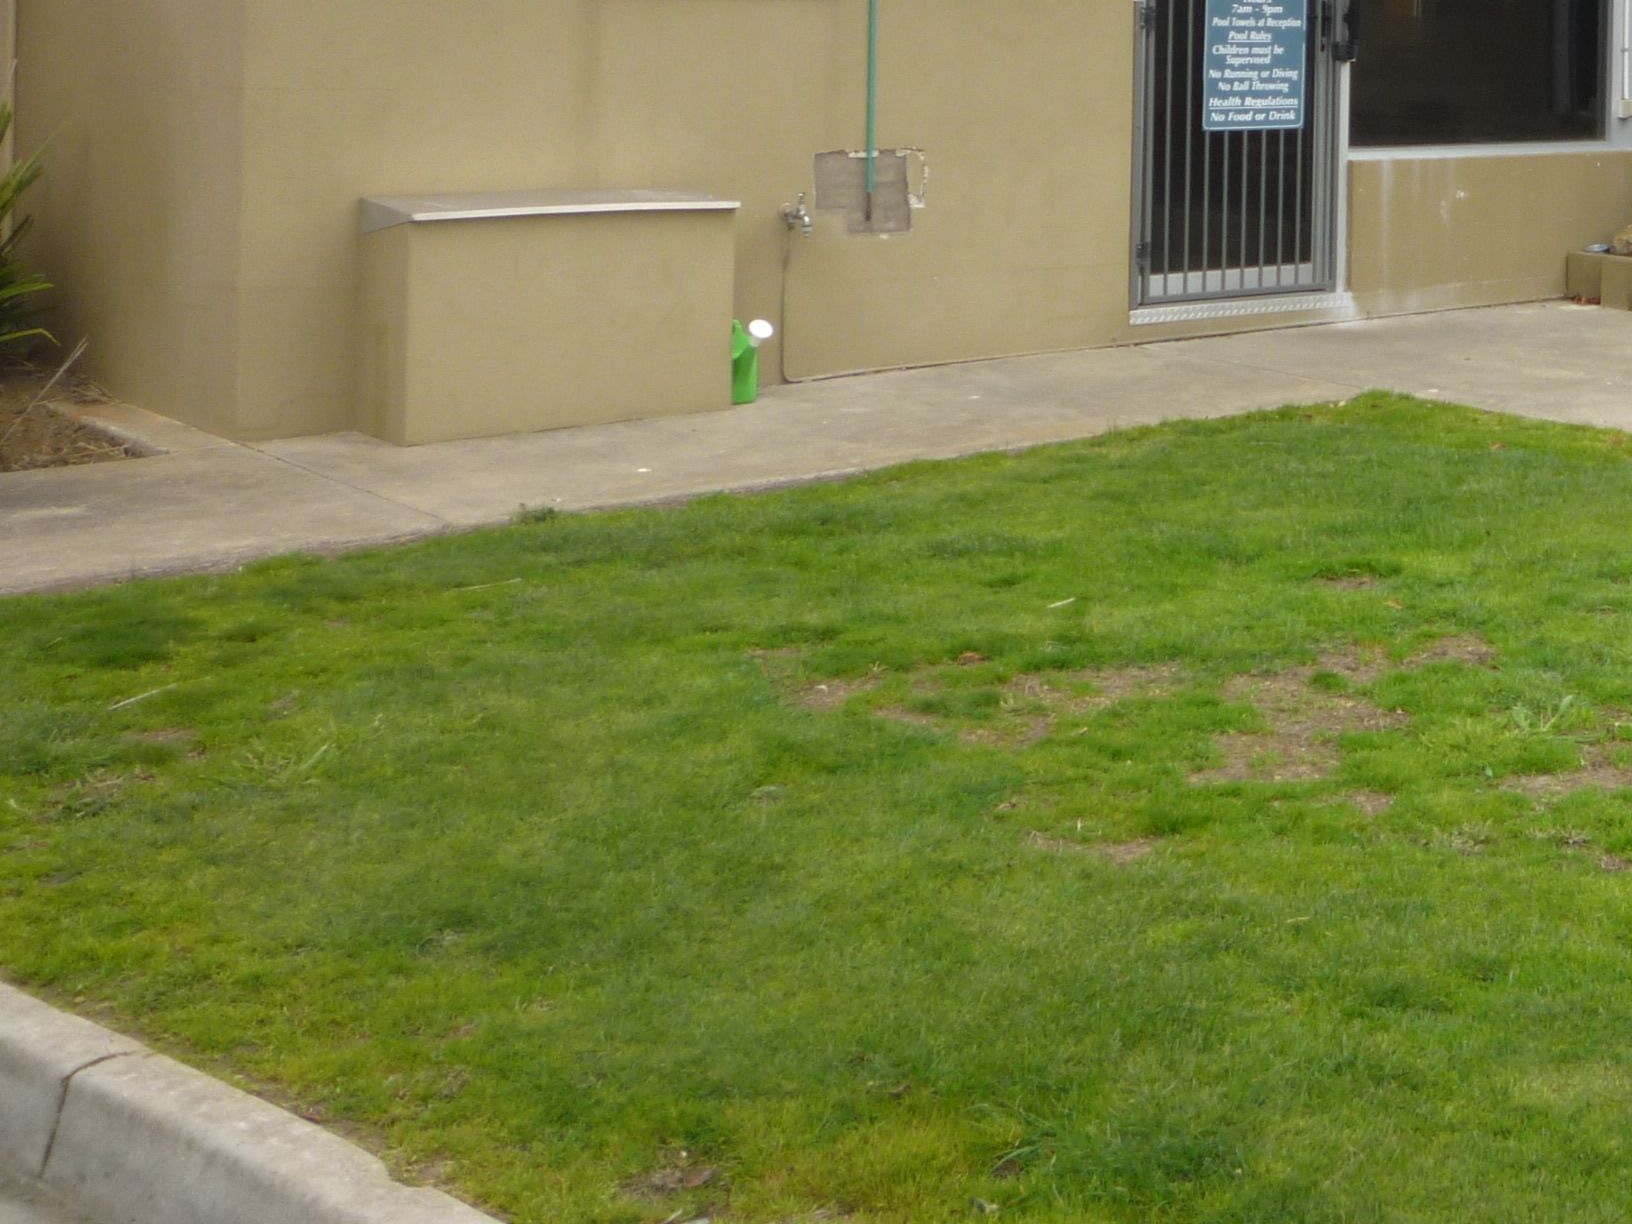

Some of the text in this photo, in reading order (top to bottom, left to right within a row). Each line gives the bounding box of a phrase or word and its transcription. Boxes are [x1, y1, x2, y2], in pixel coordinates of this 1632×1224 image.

[1231, 4, 1253, 13] 7am
[1211, 17, 1230, 26] Pool
[1231, 17, 1256, 27] Towels
[1266, 17, 1302, 29] Reception
[1228, 30, 1272, 40] Pool Rules
[1212, 44, 1285, 55] Children must be
[1225, 55, 1272, 67] Supervised
[1208, 68, 1299, 81] No Running or Diving
[1218, 80, 1289, 93] No Ball Throwing
[1208, 96, 1299, 108] Health Regulations
[1210, 109, 1296, 121] No Food or Drink
